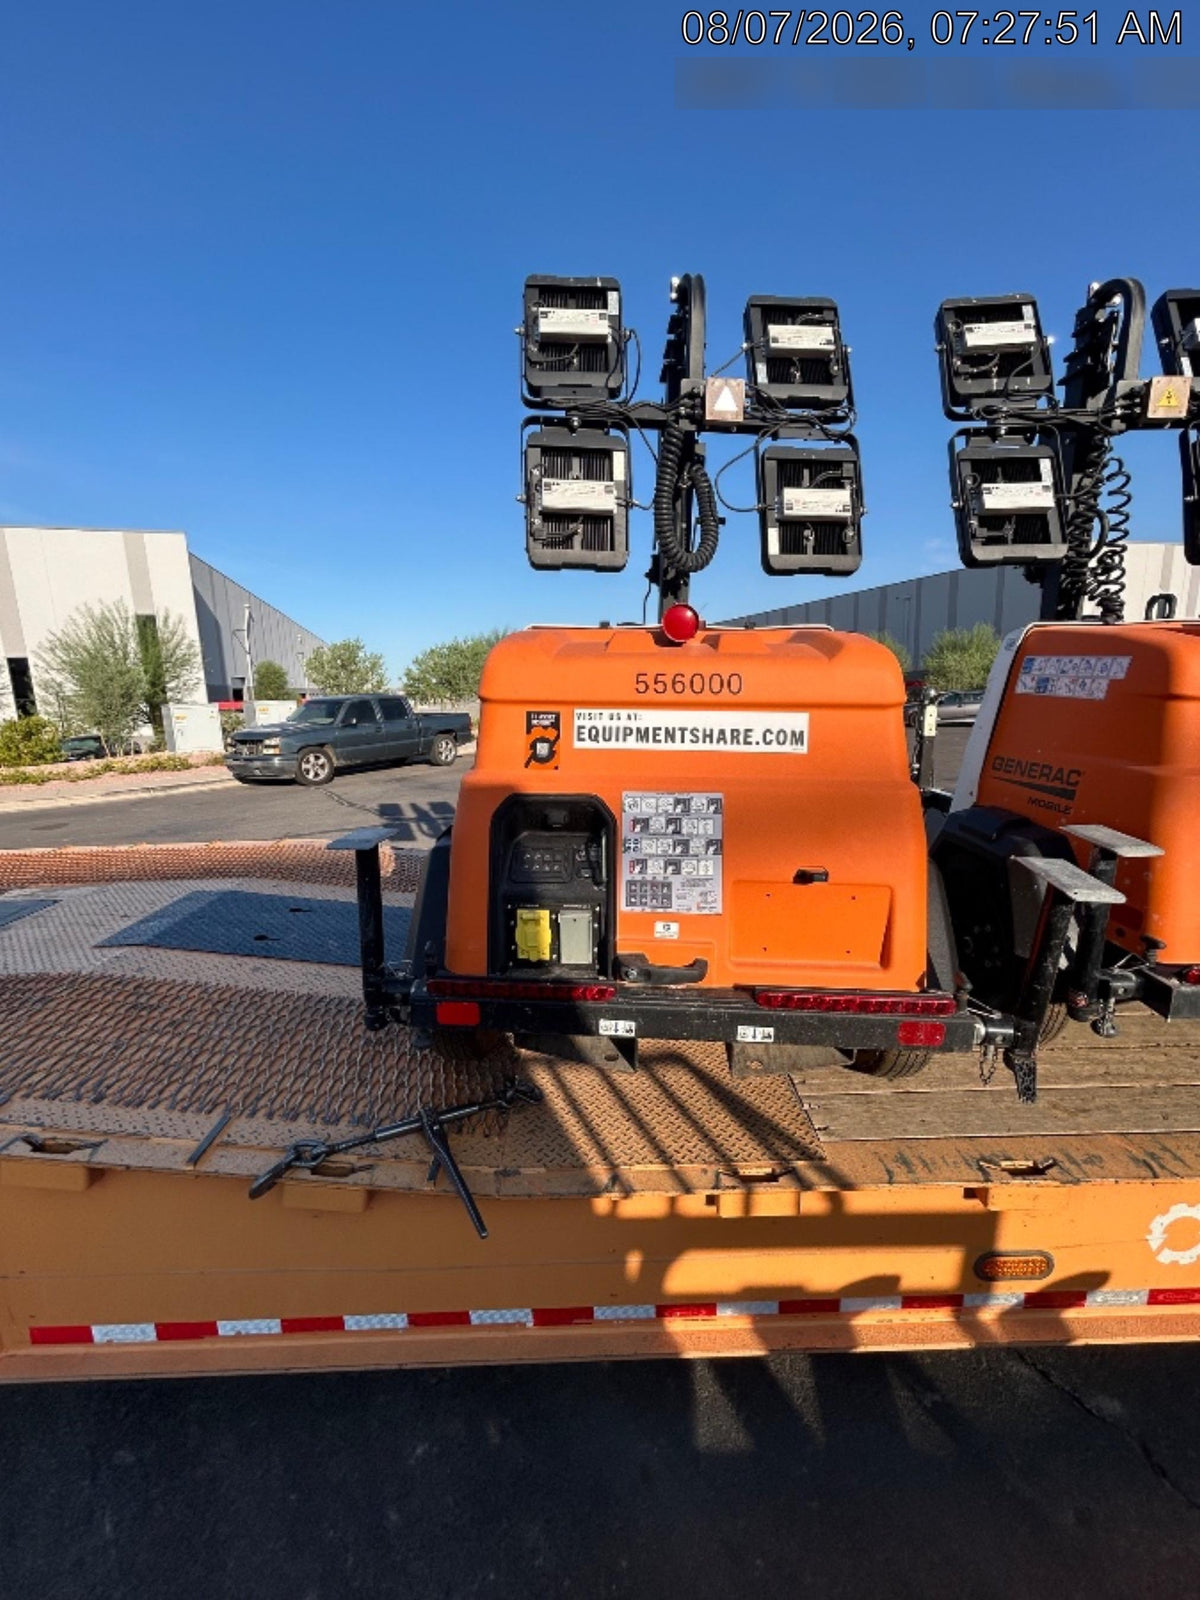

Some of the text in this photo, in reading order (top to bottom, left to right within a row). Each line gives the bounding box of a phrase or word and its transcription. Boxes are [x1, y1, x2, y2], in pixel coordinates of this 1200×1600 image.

[635, 673, 743, 695] 556000
[576, 712, 604, 721] VISIT
[609, 712, 621, 721] US
[576, 725, 805, 747] EQUIPMENTSHARE.COM
[992, 756, 1082, 787] GENERAC
[1027, 796, 1074, 815] MOBILE
